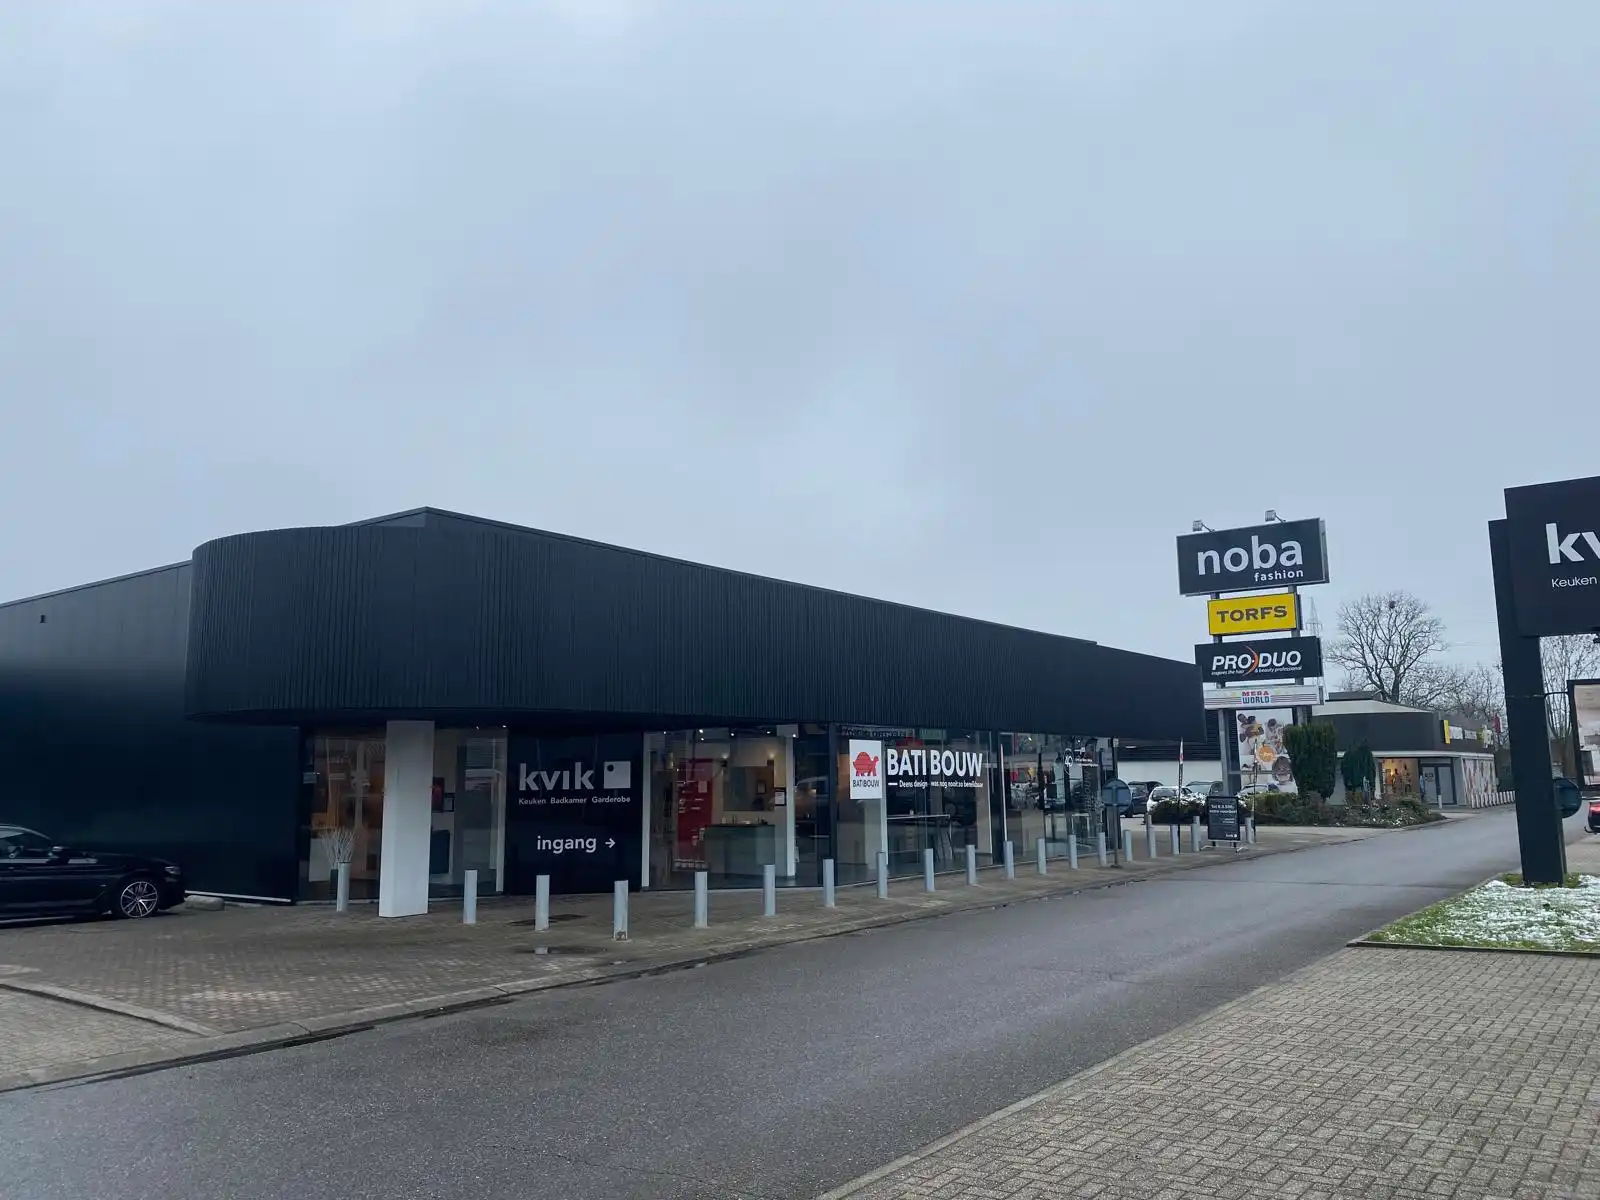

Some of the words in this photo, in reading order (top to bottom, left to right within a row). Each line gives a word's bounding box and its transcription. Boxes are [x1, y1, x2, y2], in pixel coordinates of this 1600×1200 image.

[1198, 535, 1303, 575] noba
[1254, 569, 1304, 582] fashion
[1551, 576, 1598, 588] Keuken
[1216, 605, 1288, 623] TORFS
[519, 761, 594, 791] kvik
[852, 779, 880, 788] BATIBOUW
[518, 797, 546, 805] Keuken
[550, 796, 587, 804] Badkamer
[591, 795, 631, 803] Garderobe
[537, 835, 597, 854] ingang
